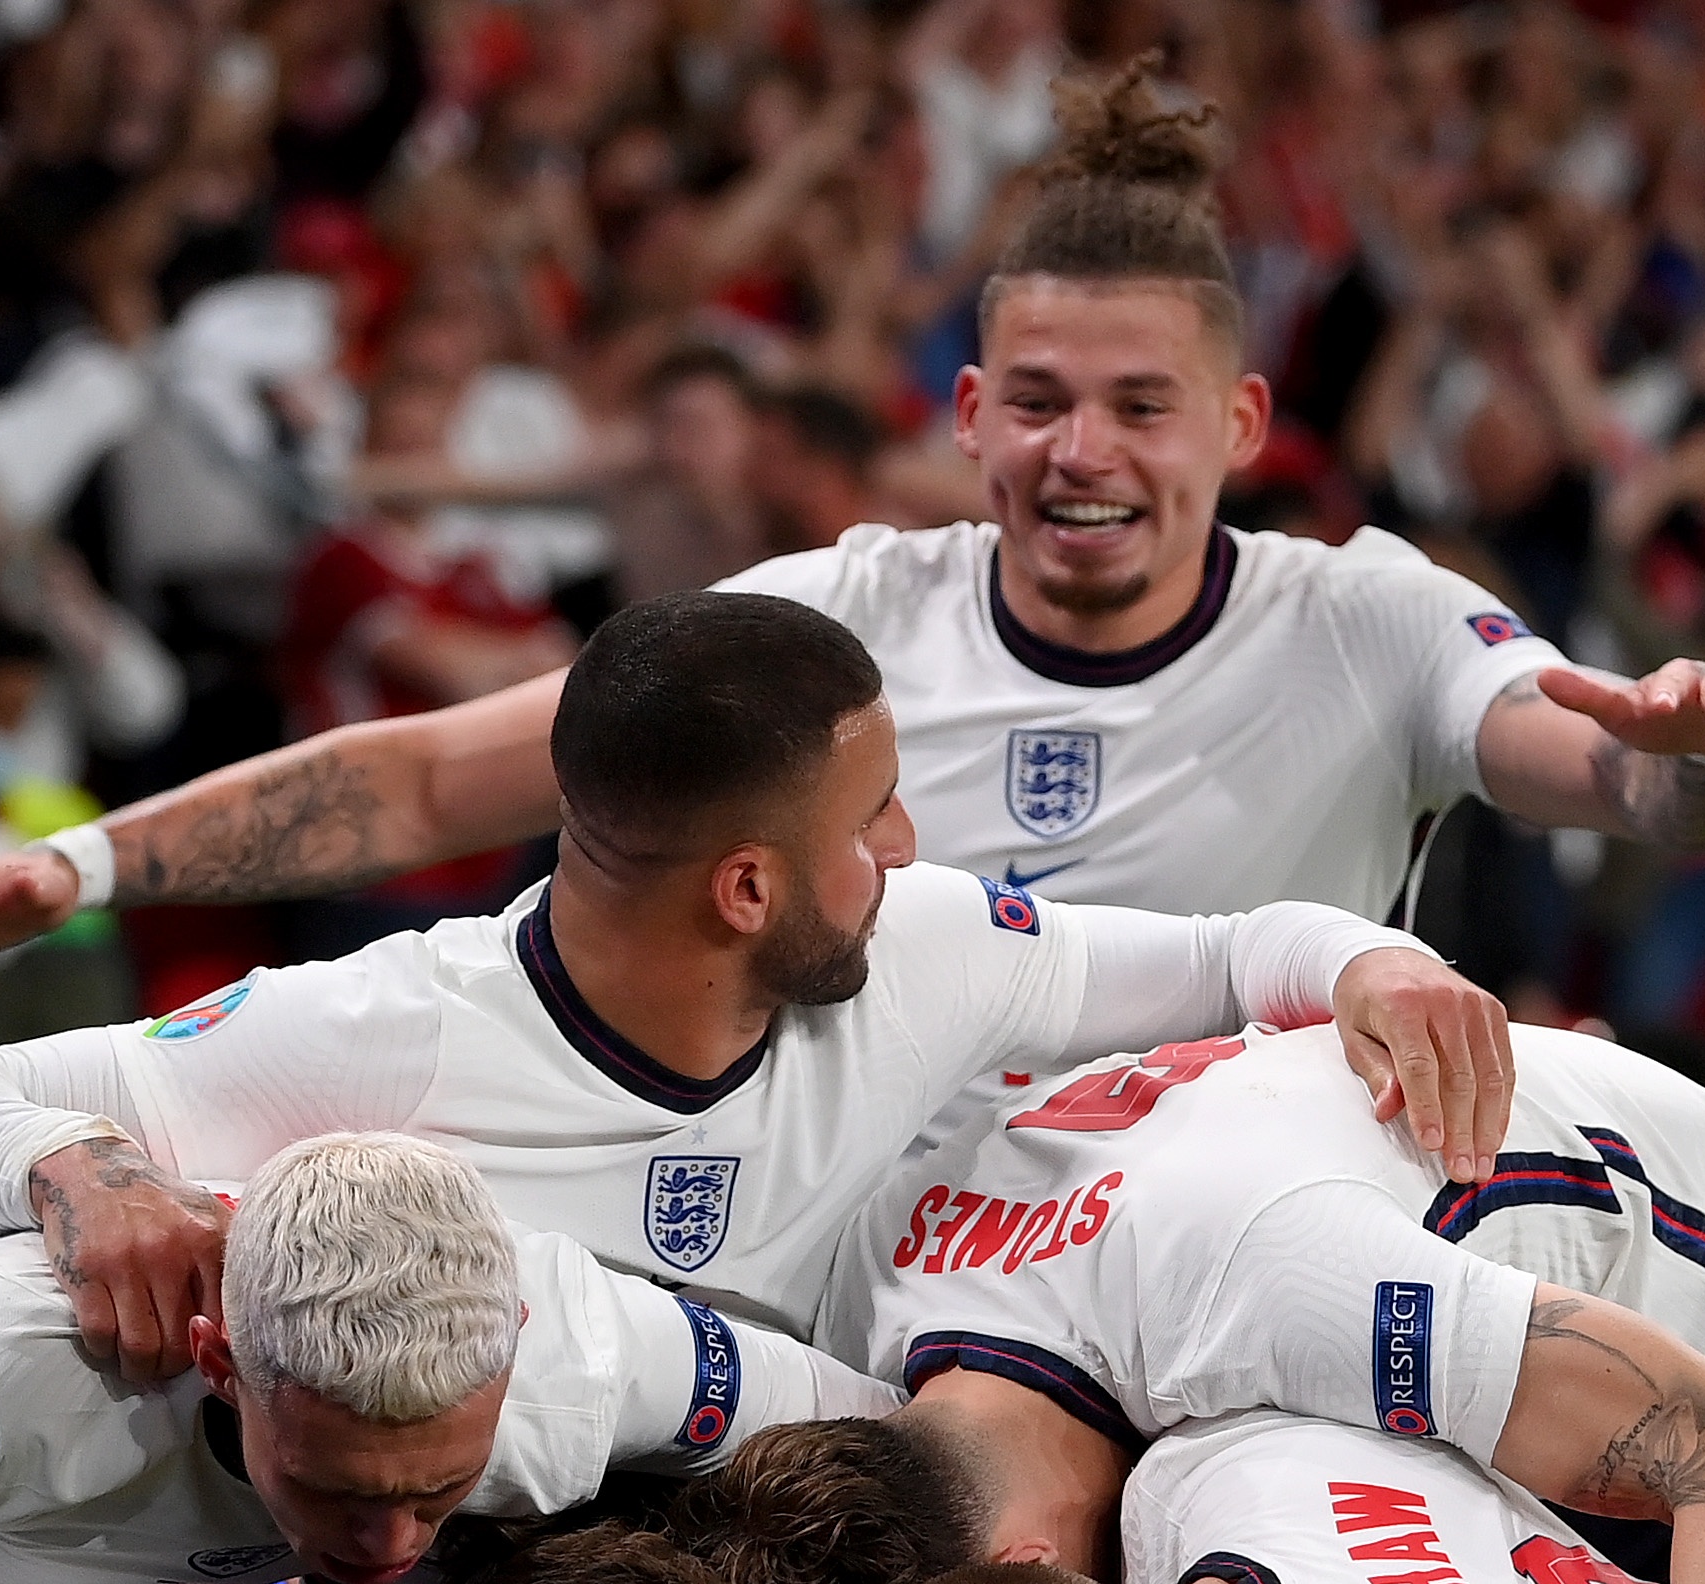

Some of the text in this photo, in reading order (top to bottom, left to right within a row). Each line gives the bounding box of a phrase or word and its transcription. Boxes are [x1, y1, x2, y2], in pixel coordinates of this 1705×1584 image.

[893, 1170, 1124, 1275] STONES
[687, 1298, 728, 1401] RESPECT
[1390, 1284, 1417, 1404] RESPECT
